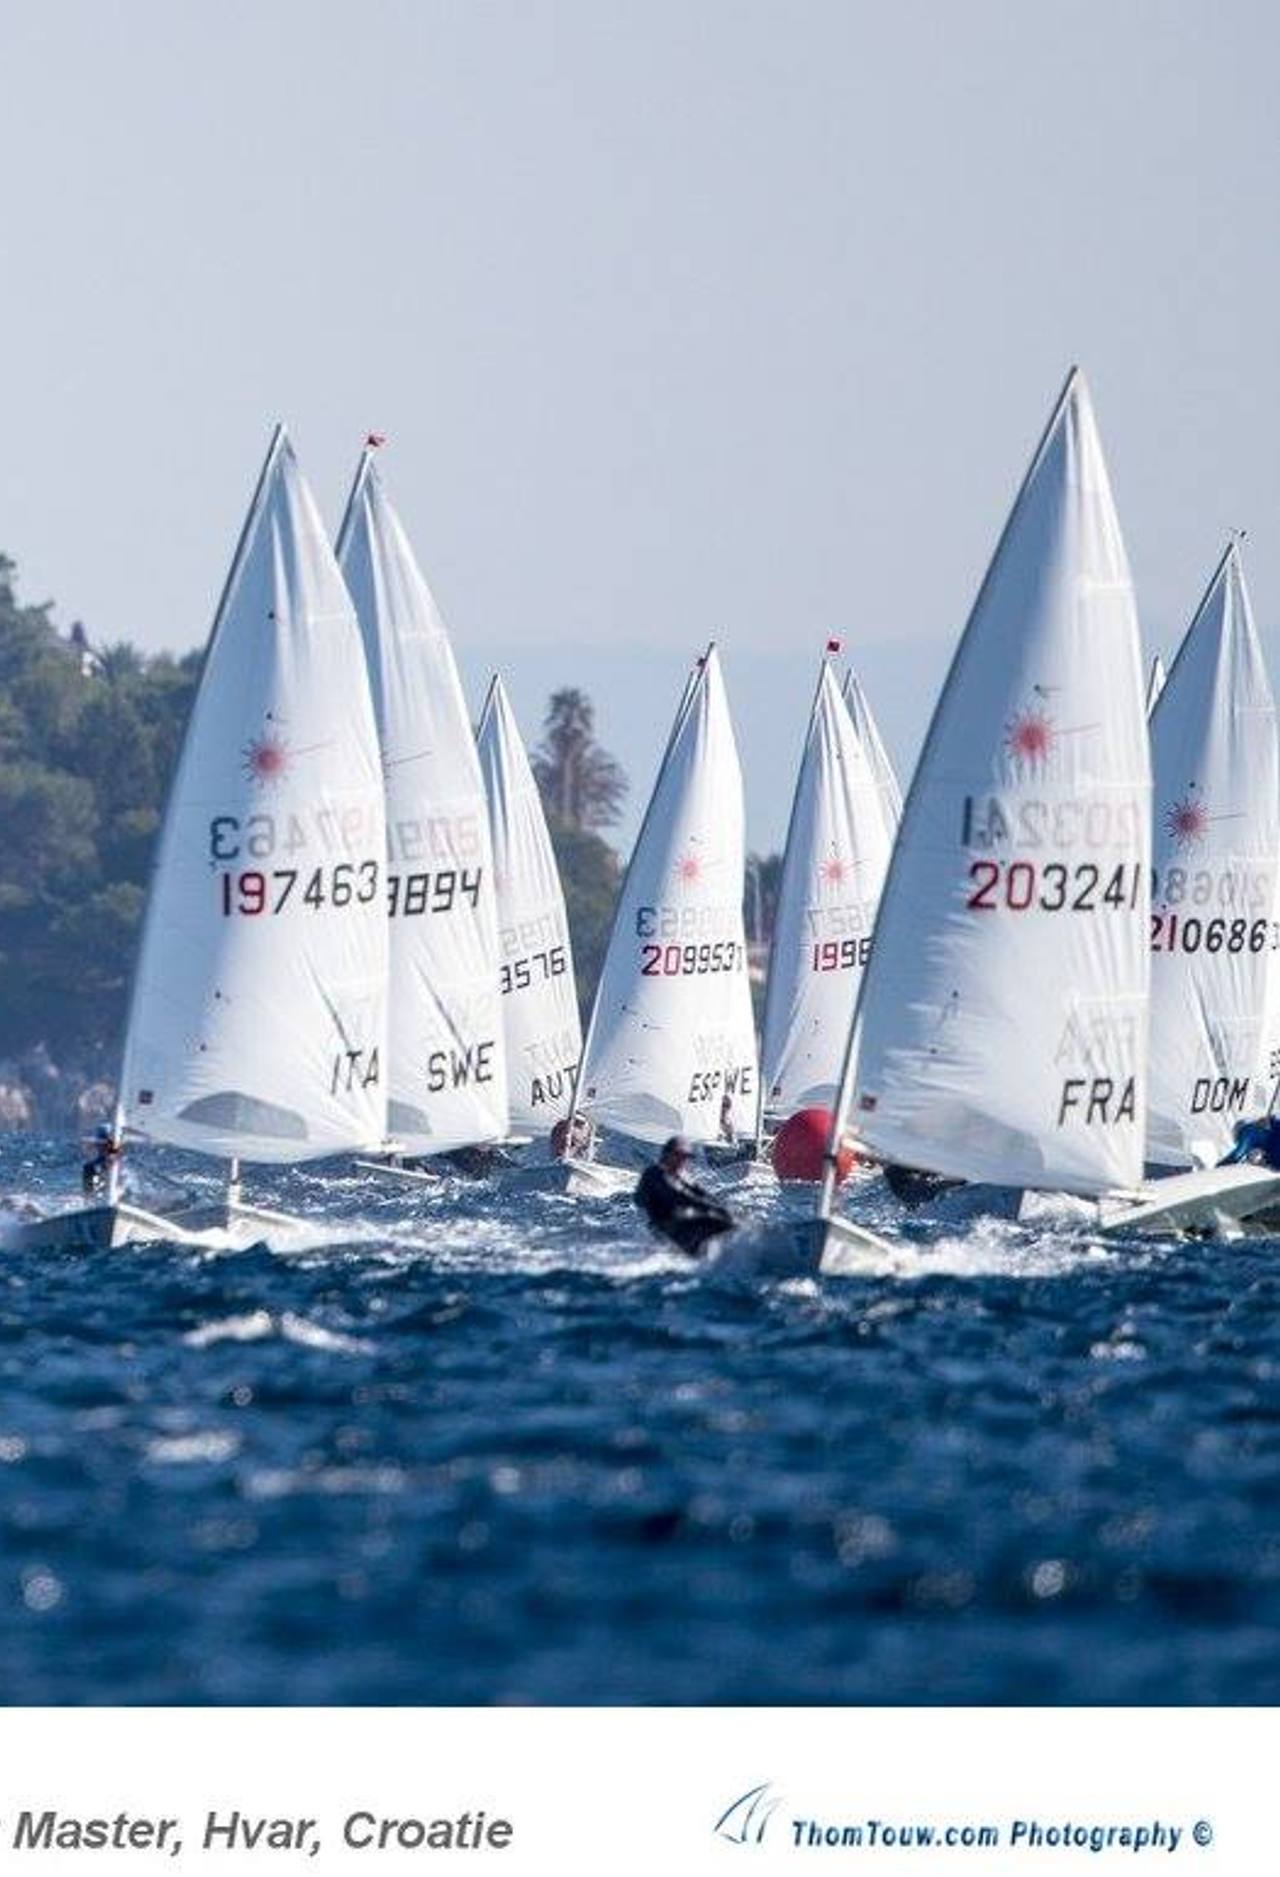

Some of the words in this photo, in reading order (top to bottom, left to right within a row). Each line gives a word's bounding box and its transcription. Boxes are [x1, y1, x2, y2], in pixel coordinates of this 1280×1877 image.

[222, 861, 378, 917] 197463
[967, 861, 1140, 911] 203241
[1151, 914, 1267, 954] 210686
[330, 1048, 380, 1095] ITA
[428, 1041, 495, 1092] SWE
[1058, 1076, 1136, 1126] FRA
[1191, 1077, 1250, 1115] DOM
